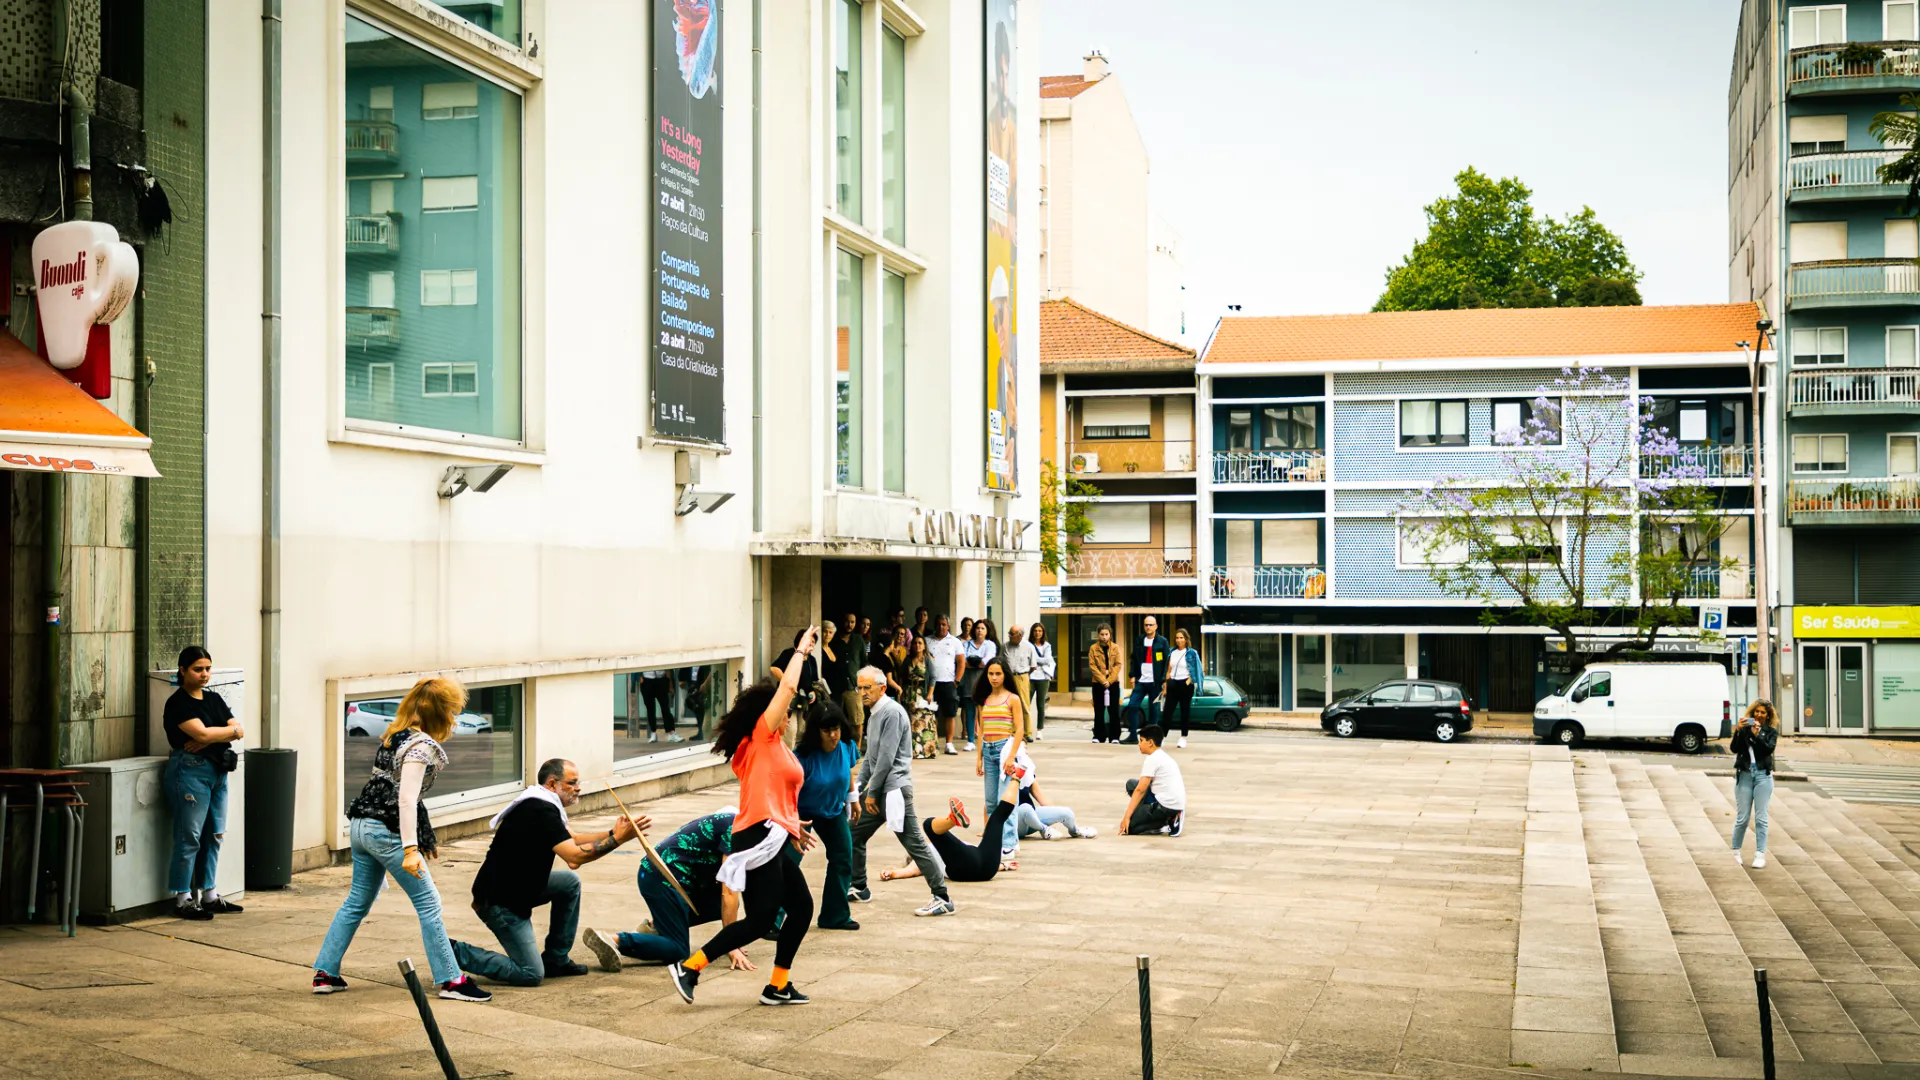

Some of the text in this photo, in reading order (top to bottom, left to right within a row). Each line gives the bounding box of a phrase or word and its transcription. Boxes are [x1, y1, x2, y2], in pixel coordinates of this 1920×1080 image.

[661, 115, 702, 155] It's a Long
[661, 137, 701, 176] Yesterday
[661, 191, 670, 206] 27
[689, 203, 706, 222] 21h30
[661, 211, 709, 243] Paços da Cultura
[661, 250, 700, 277] Companhia
[661, 270, 710, 300] Portuguesa de
[661, 290, 688, 311] Bailado
[661, 310, 715, 339] Contemporâneo
[661, 331, 670, 346] 28
[688, 338, 705, 355] 21h30
[661, 351, 718, 377] Casa da Criatividade
[1706, 613, 1719, 629] P
[1802, 615, 1829, 629] Ser
[1832, 615, 1880, 629] Saúde
